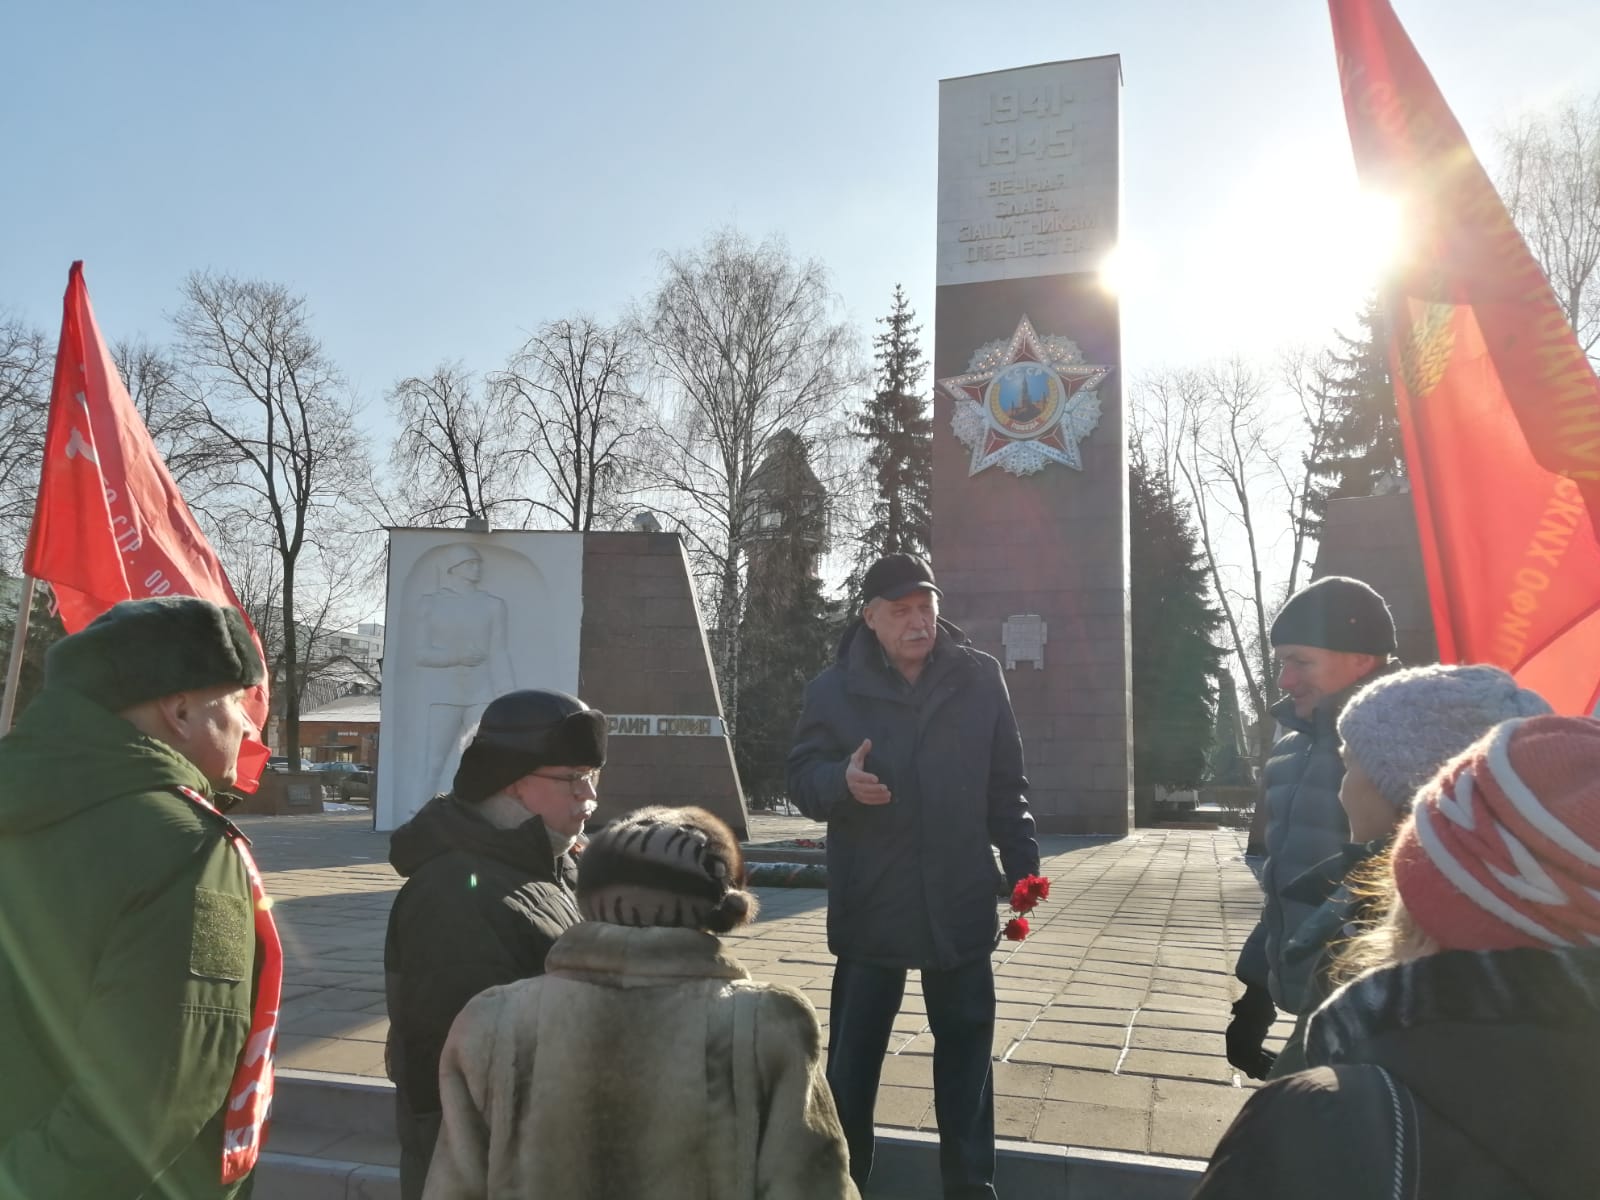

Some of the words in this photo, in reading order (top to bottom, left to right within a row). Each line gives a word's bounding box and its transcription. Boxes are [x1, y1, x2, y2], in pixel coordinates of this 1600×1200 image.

[978, 124, 1075, 167] 1945
[986, 173, 1069, 198] ВЕЧНАЯ
[995, 196, 1060, 219] СЛАВА
[959, 213, 1097, 243] ЗАЩИТНИКАМ
[607, 716, 651, 734] РЛИН
[656, 717, 712, 735] СОФИЯ
